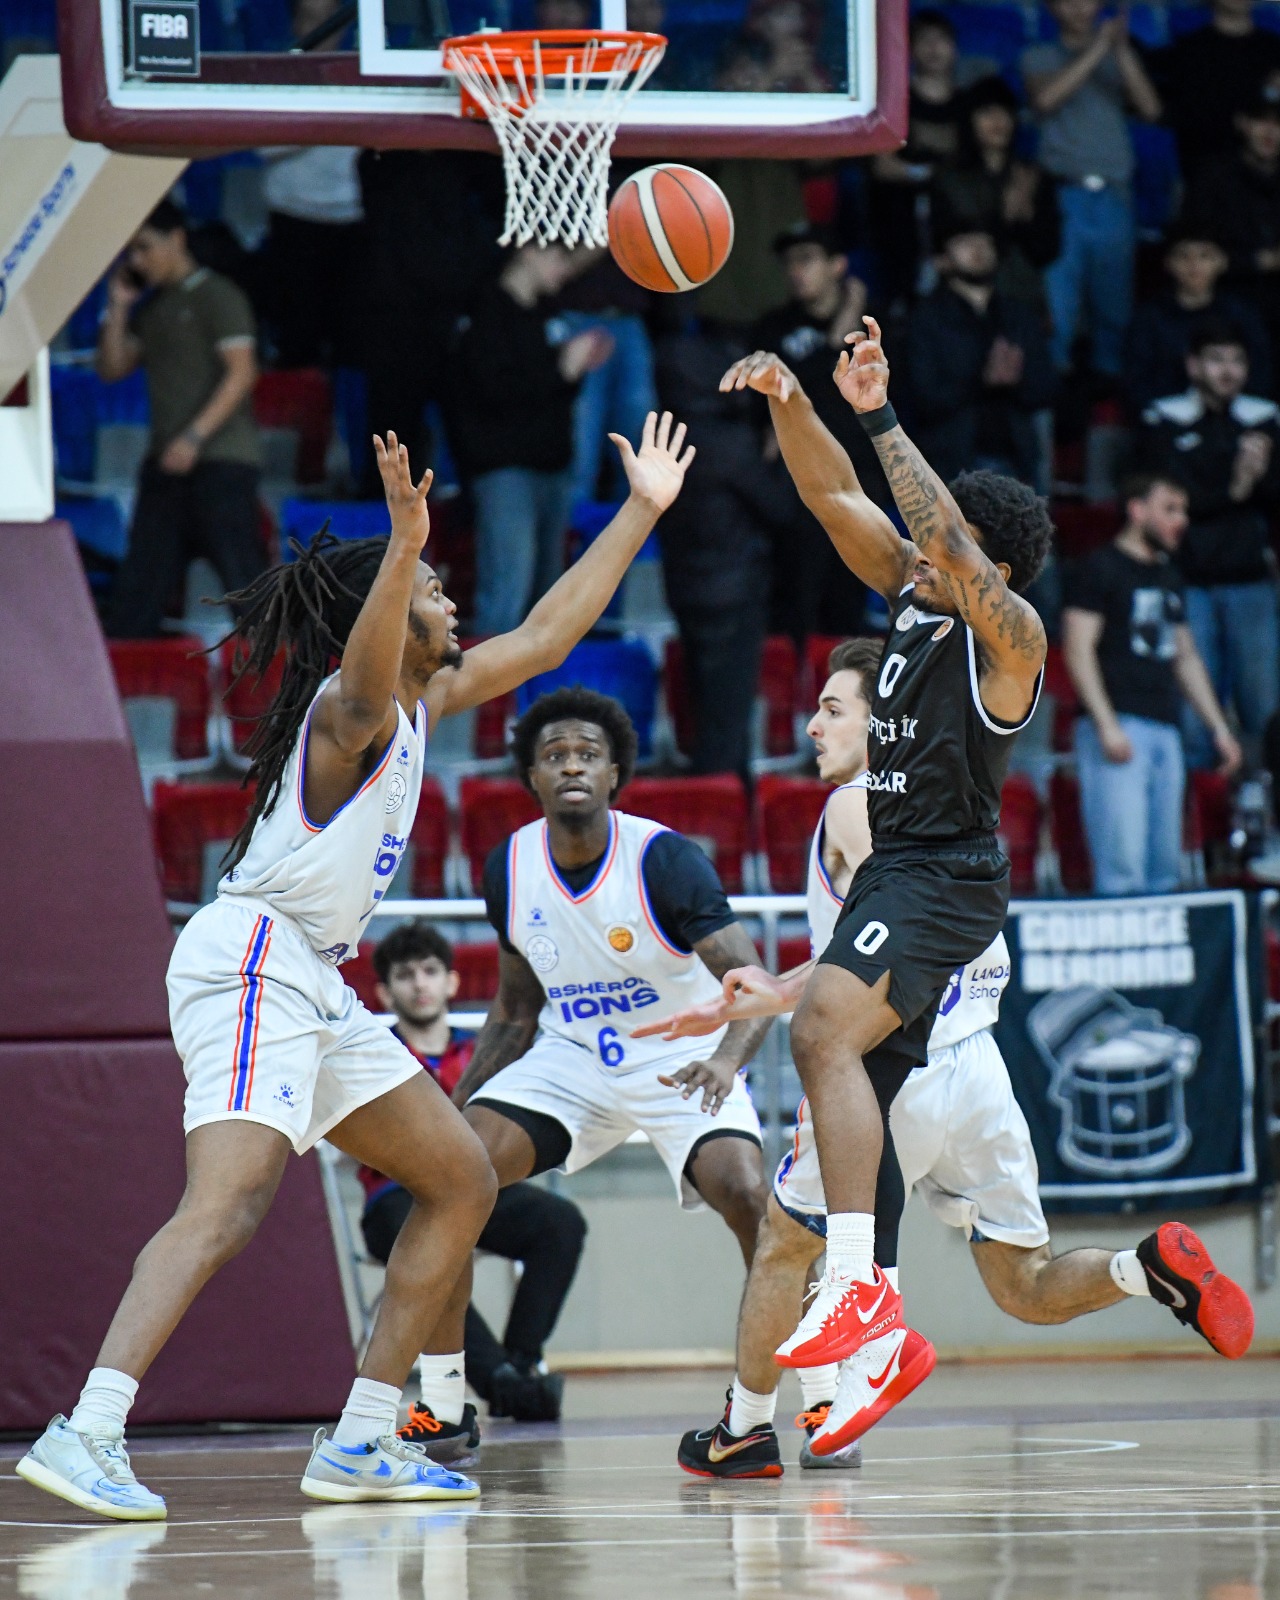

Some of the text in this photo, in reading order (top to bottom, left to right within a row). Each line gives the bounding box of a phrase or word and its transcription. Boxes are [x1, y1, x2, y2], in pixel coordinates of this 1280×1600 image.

[141, 13, 189, 39] FIBA
[878, 653, 907, 698] 0
[853, 920, 889, 955] 0
[969, 984, 1001, 999] Scho
[598, 1025, 625, 1067] 6
